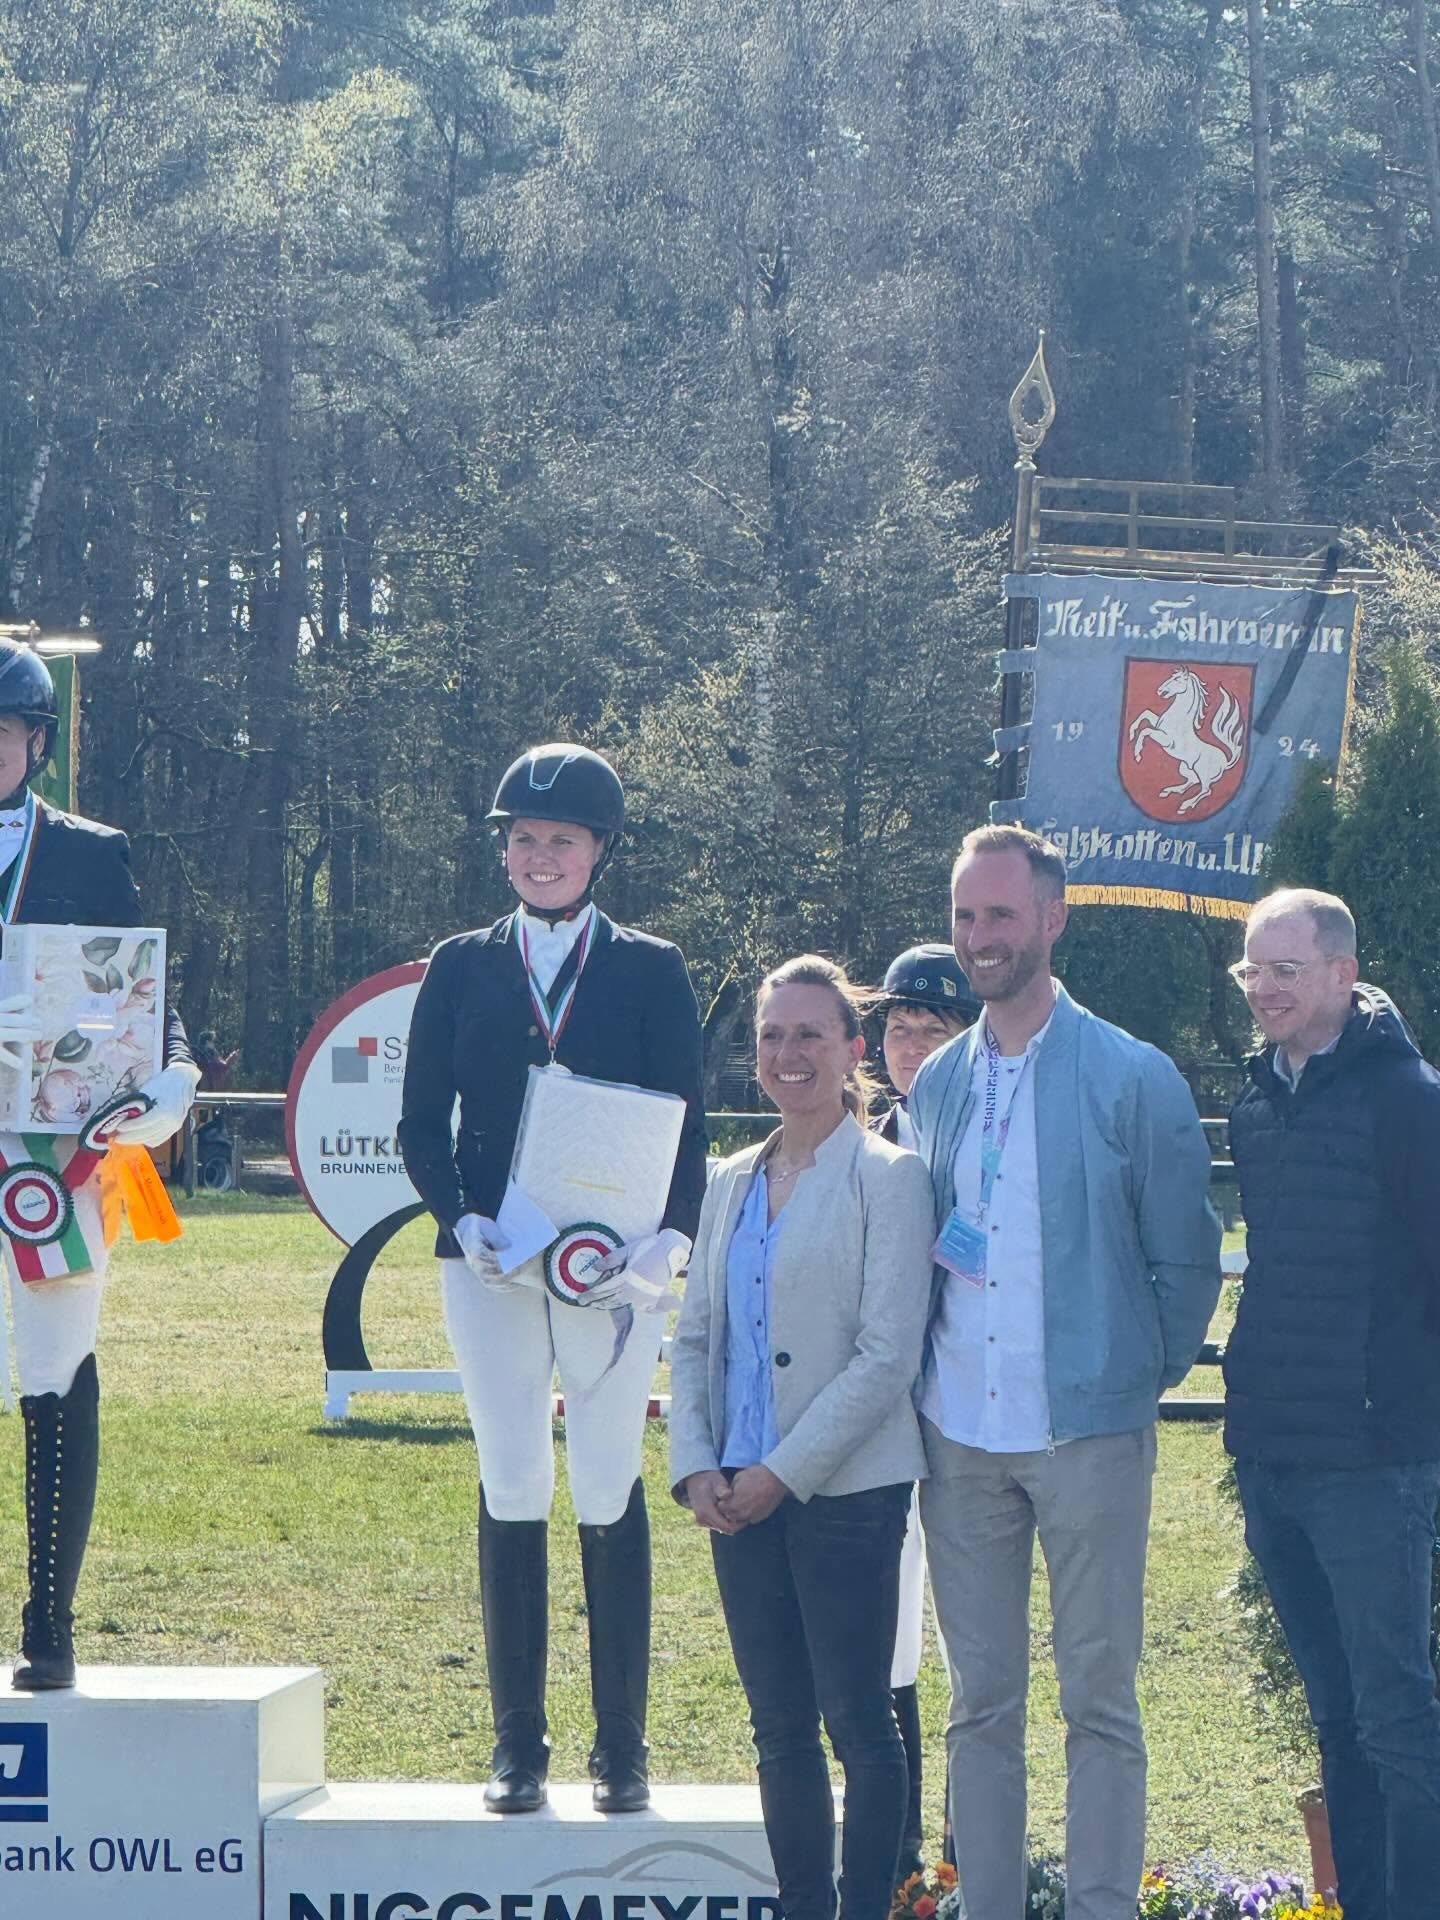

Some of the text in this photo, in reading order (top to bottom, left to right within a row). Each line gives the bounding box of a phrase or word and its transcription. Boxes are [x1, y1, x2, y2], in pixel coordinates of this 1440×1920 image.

[1051, 720, 1321, 760] 19 24
[384, 1036, 409, 1060] S
[0, 1835, 244, 1873] ank OWL eG
